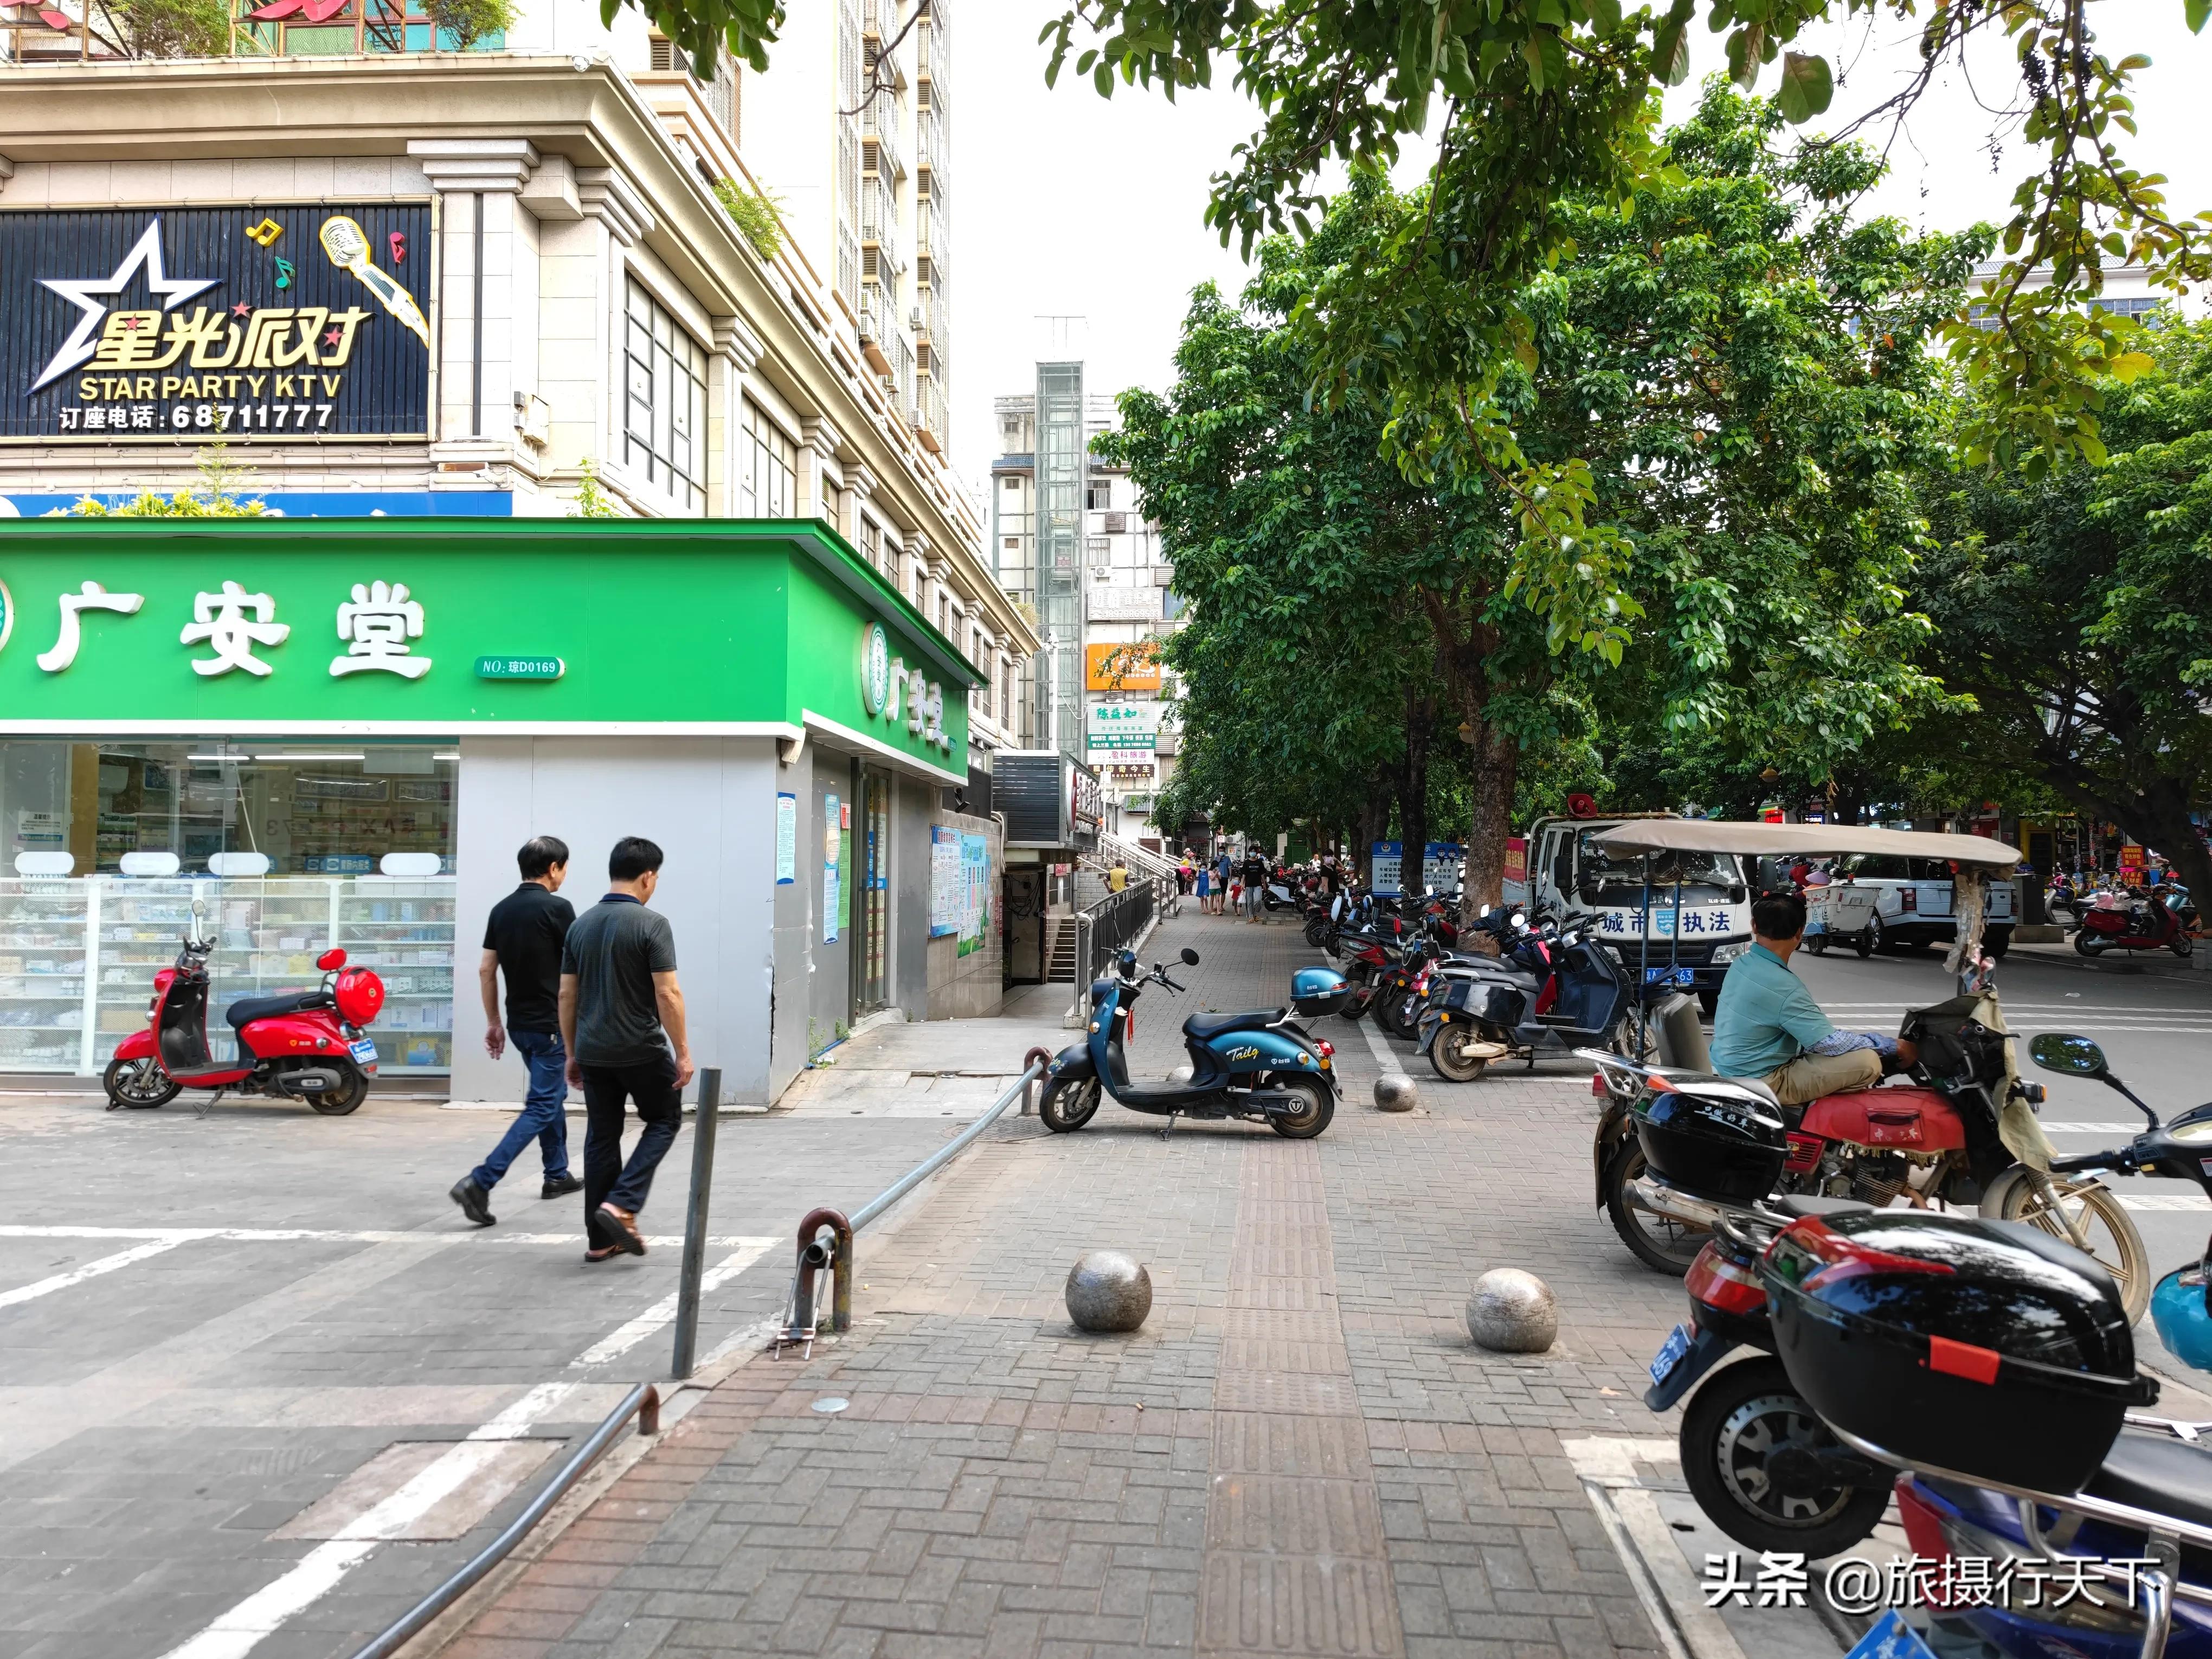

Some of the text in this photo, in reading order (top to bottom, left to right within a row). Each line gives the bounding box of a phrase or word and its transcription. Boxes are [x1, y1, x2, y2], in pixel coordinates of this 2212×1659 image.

[82, 306, 377, 371] 星光派对
[79, 375, 341, 400] STAR PARTY KTV
[36, 580, 432, 679] 广安堂
[886, 657, 942, 746] 广安堂
[1111, 751, 1147, 759] 盈科旅游
[1683, 911, 1730, 933] 执法
[1226, 1045, 1259, 1062] Tailg
